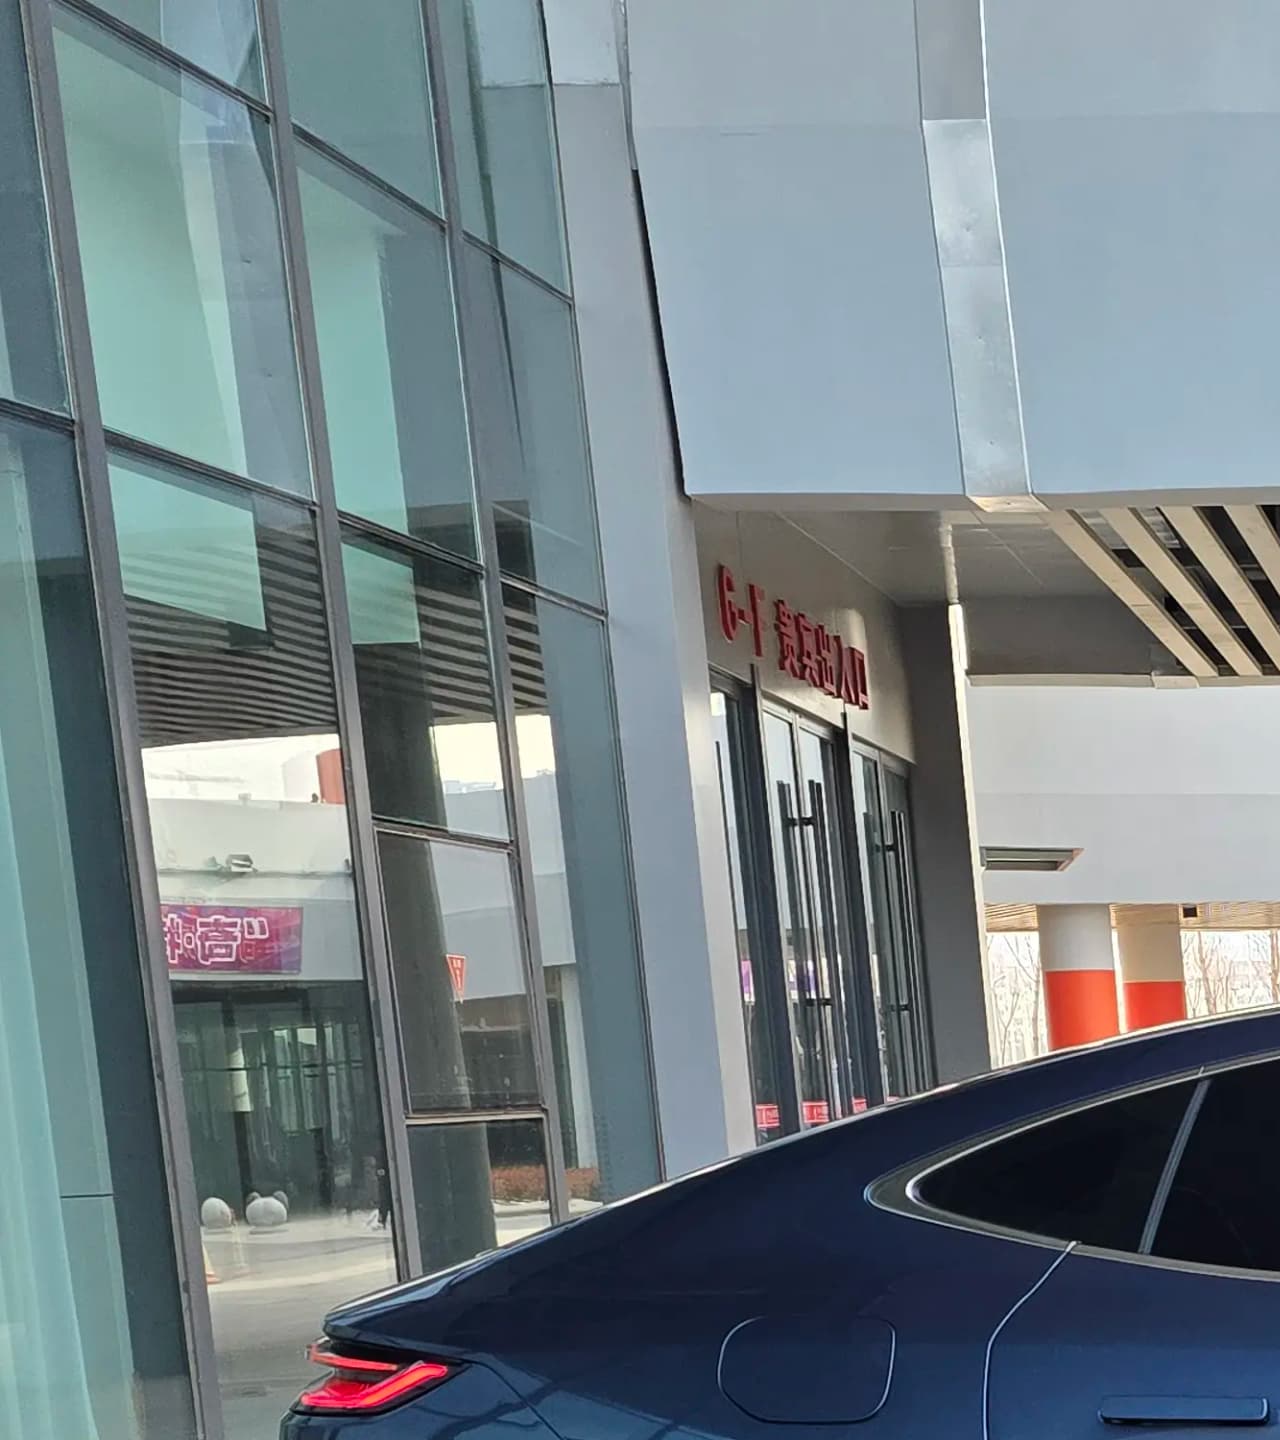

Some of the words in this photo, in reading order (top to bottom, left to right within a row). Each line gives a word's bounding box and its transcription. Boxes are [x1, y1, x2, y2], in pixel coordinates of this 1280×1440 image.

[773, 598, 870, 711] 贵宾出入口
